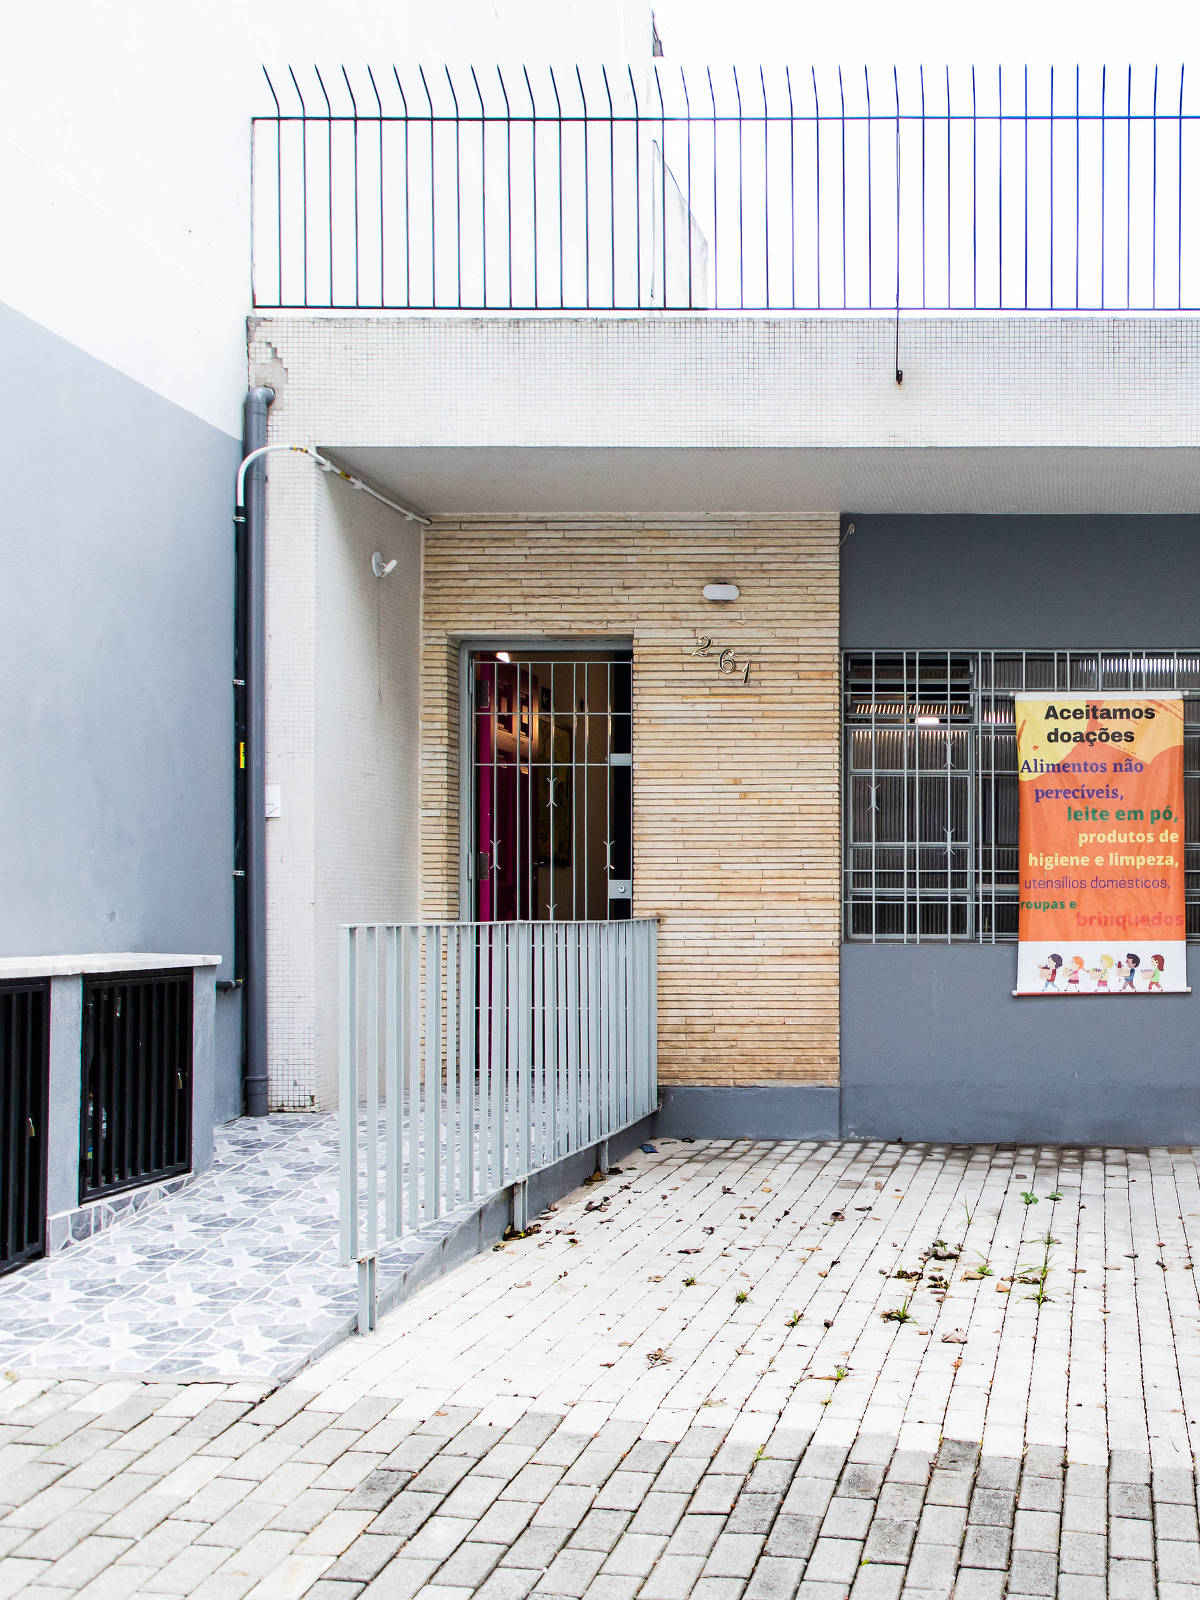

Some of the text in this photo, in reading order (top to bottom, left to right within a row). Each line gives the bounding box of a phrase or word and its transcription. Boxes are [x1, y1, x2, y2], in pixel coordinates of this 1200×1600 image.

[1044, 705, 1156, 720] Aceitamos
[1046, 727, 1135, 746] doações
[1020, 759, 1144, 773] Alimentos não
[1034, 784, 1124, 802] perecíveis,
[1067, 805, 1178, 824] leite em pó,
[1078, 830, 1179, 846] produtos de
[1028, 853, 1179, 870] higiene e limpeza,
[1024, 876, 1171, 889] utensílios domésticos,
[1020, 900, 1077, 912] roupas e
[1077, 911, 1184, 930] brinquedos
